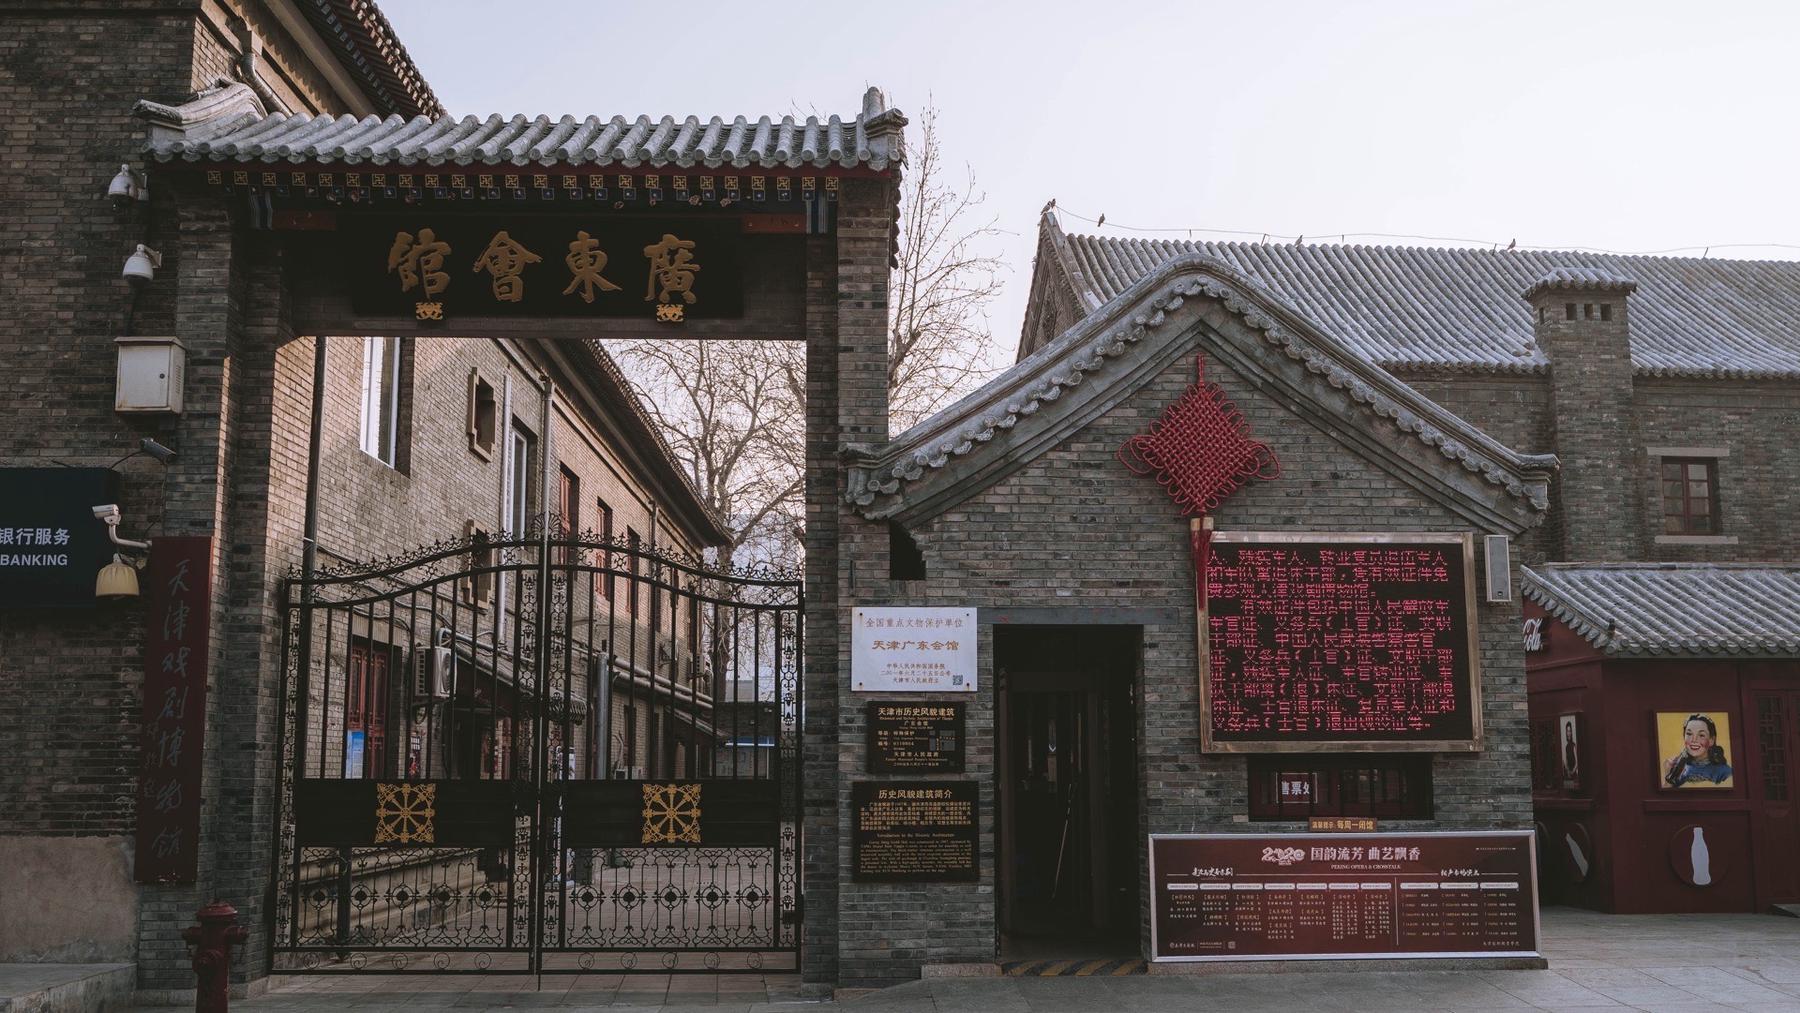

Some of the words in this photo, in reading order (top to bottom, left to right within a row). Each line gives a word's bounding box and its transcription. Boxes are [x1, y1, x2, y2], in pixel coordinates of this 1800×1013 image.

[0, 528, 70, 545] 银行服务
[0, 554, 68, 566] BANKING
[865, 618, 963, 628] 全国重点文物保护单位
[871, 640, 960, 651] 天津广东会馆
[878, 707, 955, 717] 天津市历史风貌建筑
[878, 789, 953, 799] 历史风貌建筑简介
[1311, 847, 1364, 861] 国韵流芳
[1368, 847, 1421, 861] 曲艺飘香
